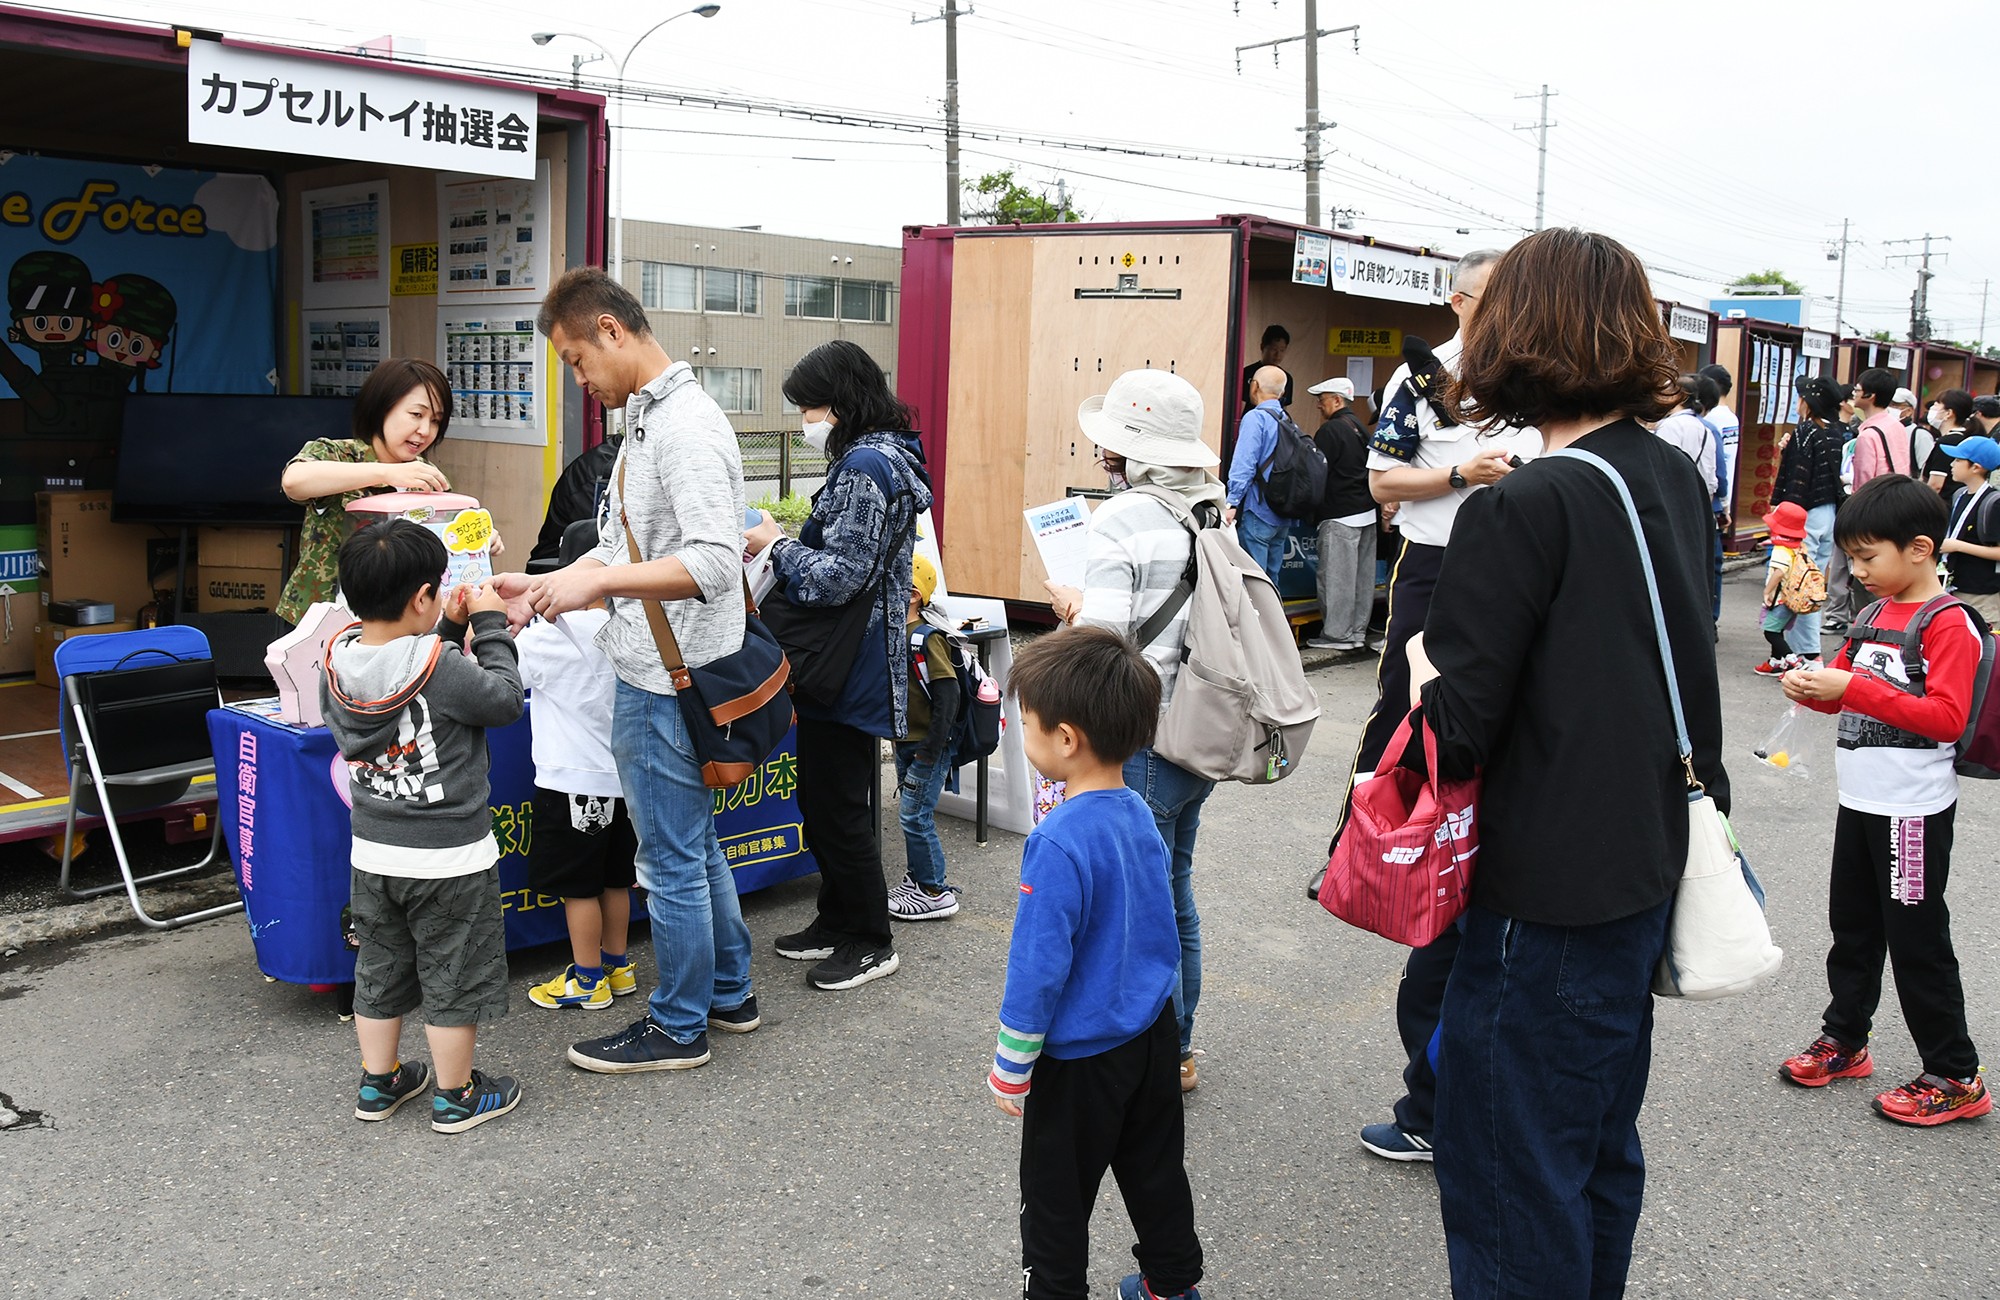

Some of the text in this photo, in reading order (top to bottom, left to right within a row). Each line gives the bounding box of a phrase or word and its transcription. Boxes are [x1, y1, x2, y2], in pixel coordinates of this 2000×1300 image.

[201, 73, 530, 153] カプセルトイ抽選会
[42, 182, 206, 242] Force
[1350, 259, 1430, 291] JR貨物グッズ販売
[1339, 329, 1391, 345] 偏積注意
[1385, 406, 1418, 429] 広報
[209, 581, 266, 600] GACHACUBE
[238, 731, 257, 891] 自衛官募集
